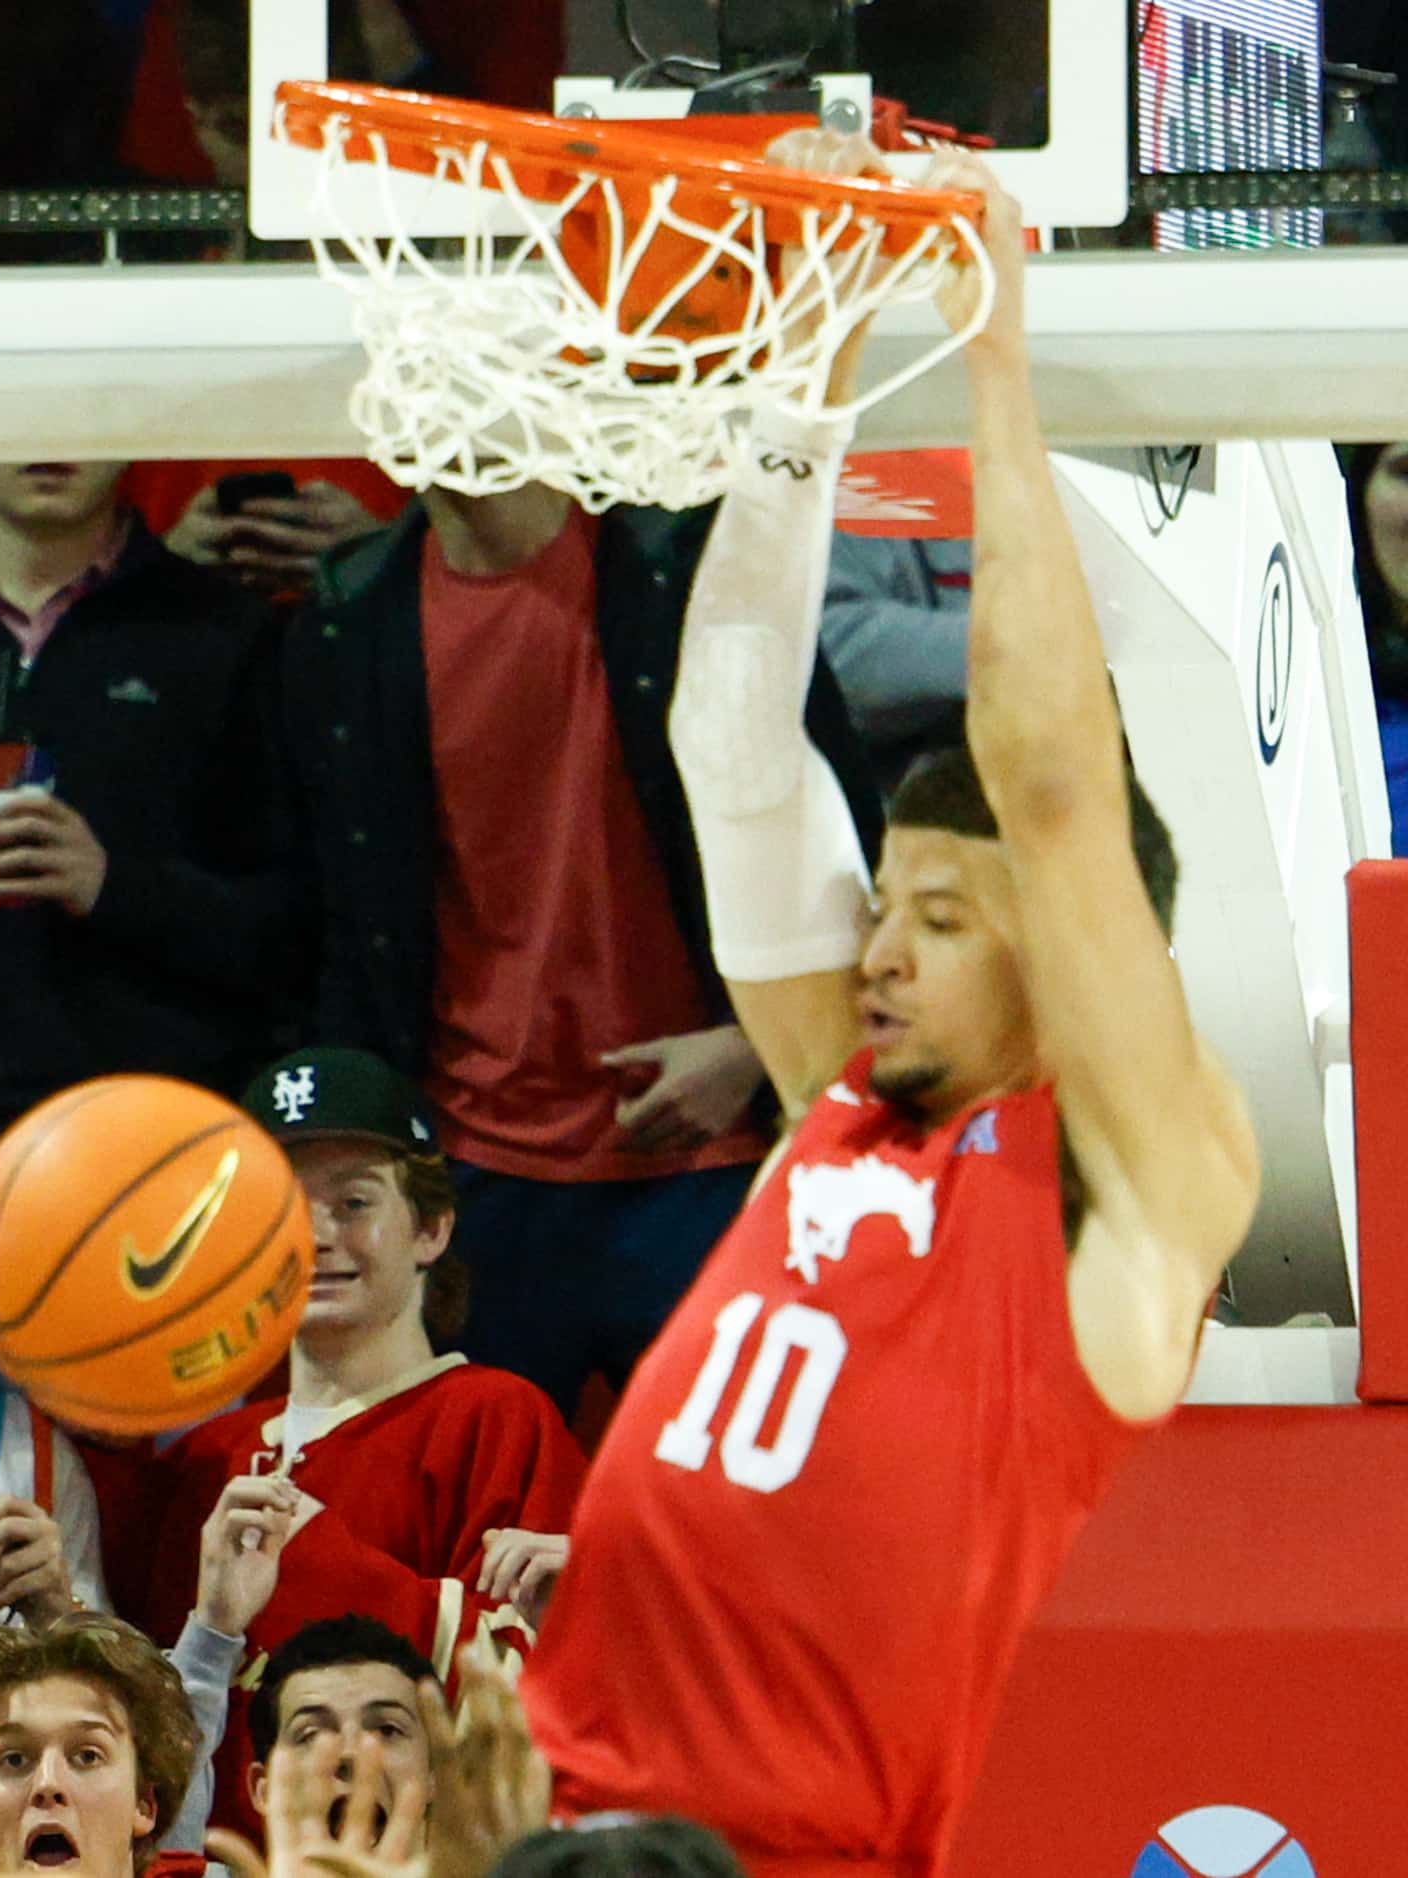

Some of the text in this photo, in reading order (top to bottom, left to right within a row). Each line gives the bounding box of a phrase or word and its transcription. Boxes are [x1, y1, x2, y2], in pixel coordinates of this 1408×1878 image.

[272, 1065, 315, 1123] NY
[171, 1246, 302, 1381] ELITE
[654, 1291, 848, 1494] 10
